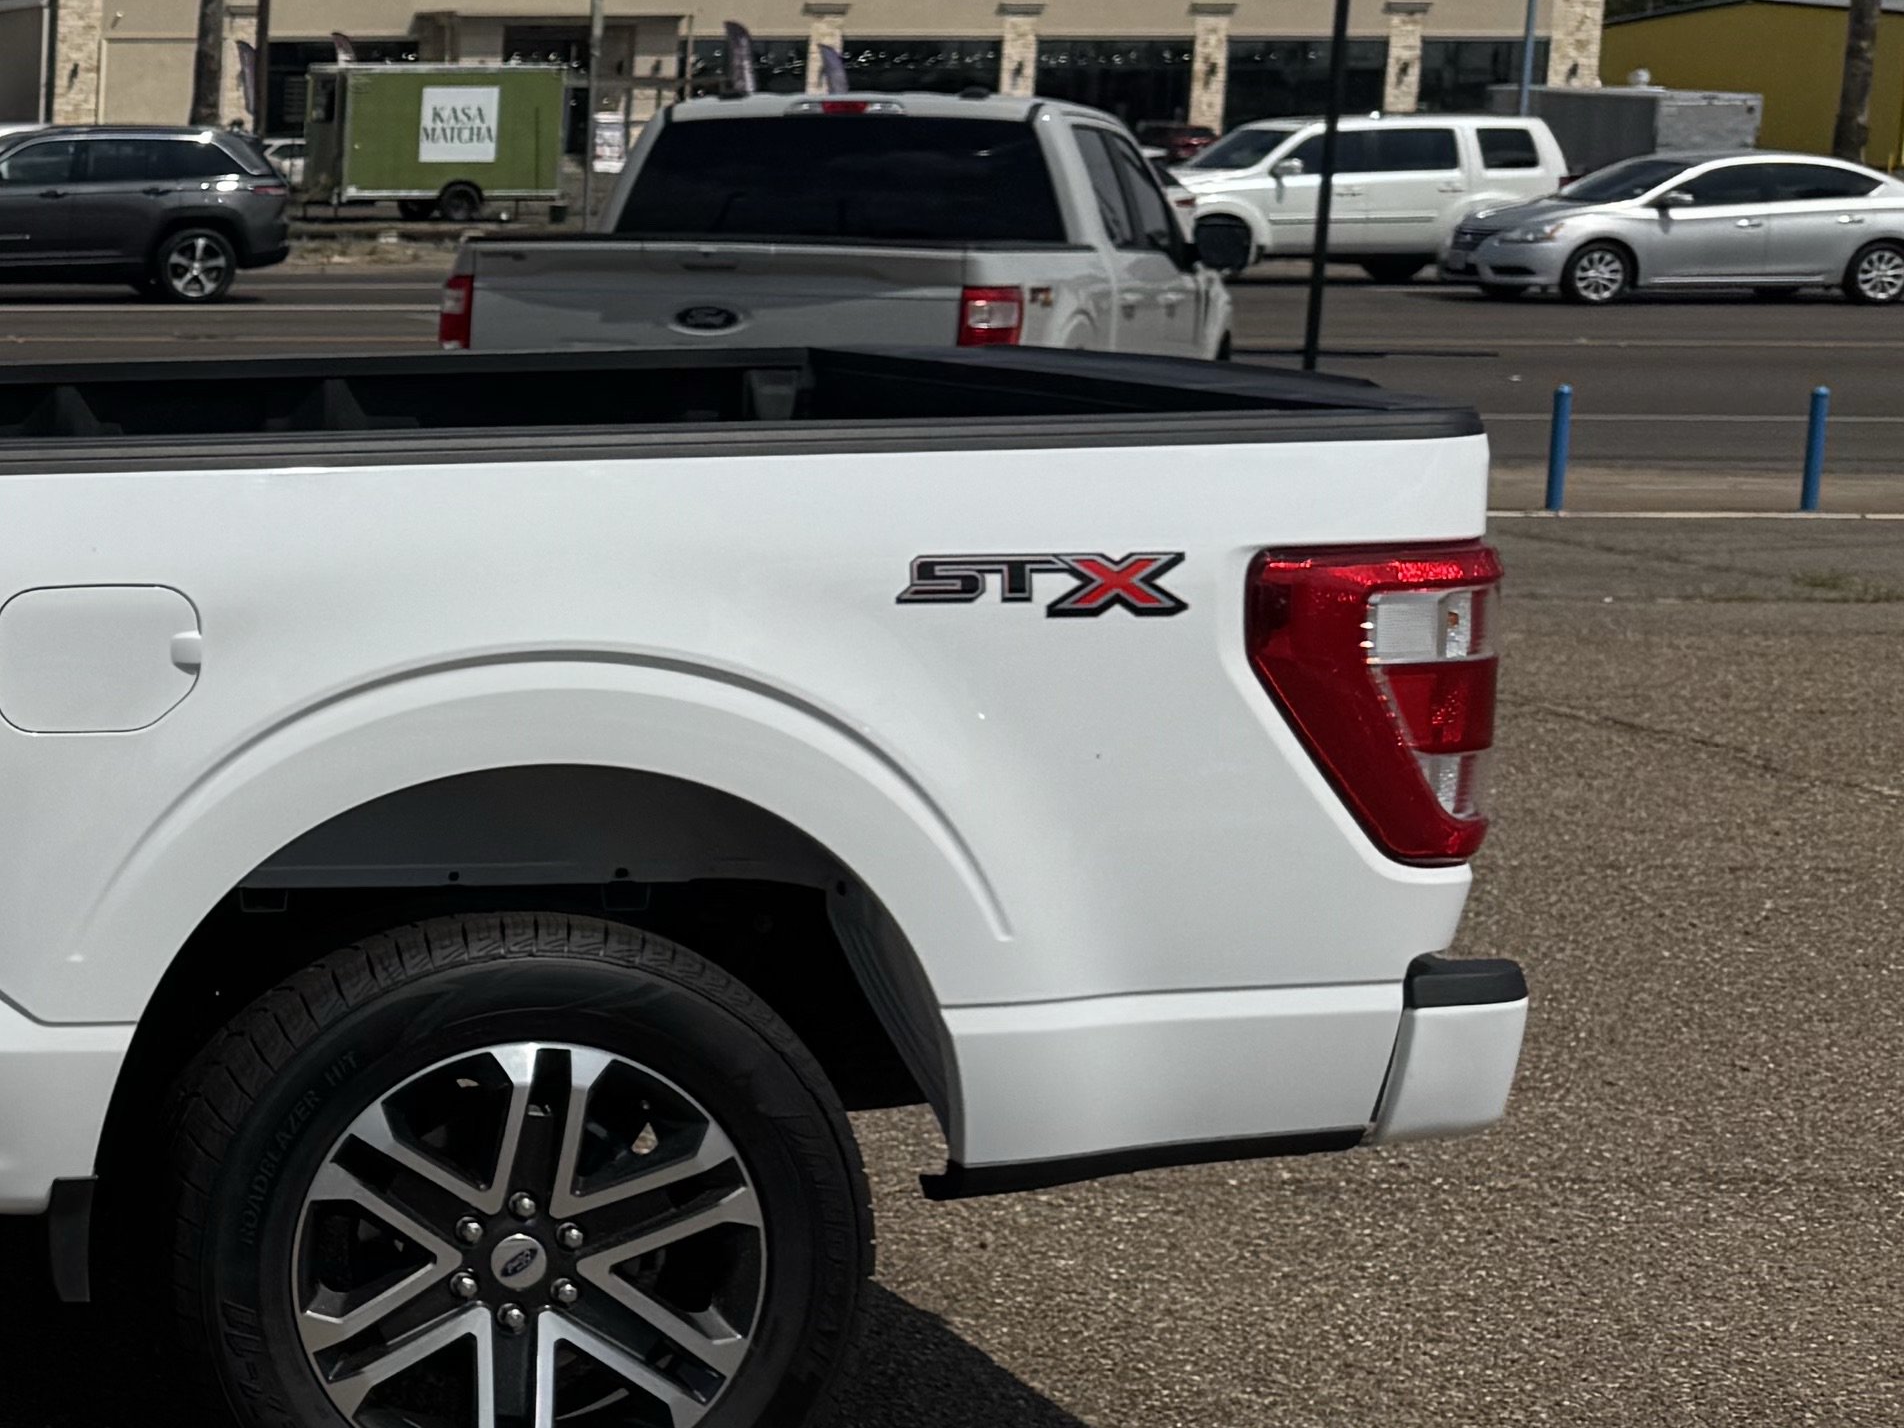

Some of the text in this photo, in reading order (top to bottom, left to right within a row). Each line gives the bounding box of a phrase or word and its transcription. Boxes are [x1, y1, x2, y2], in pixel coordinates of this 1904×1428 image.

[431, 106, 486, 125] KASA
[421, 126, 494, 145] MATCHA
[895, 551, 1190, 618] STX
